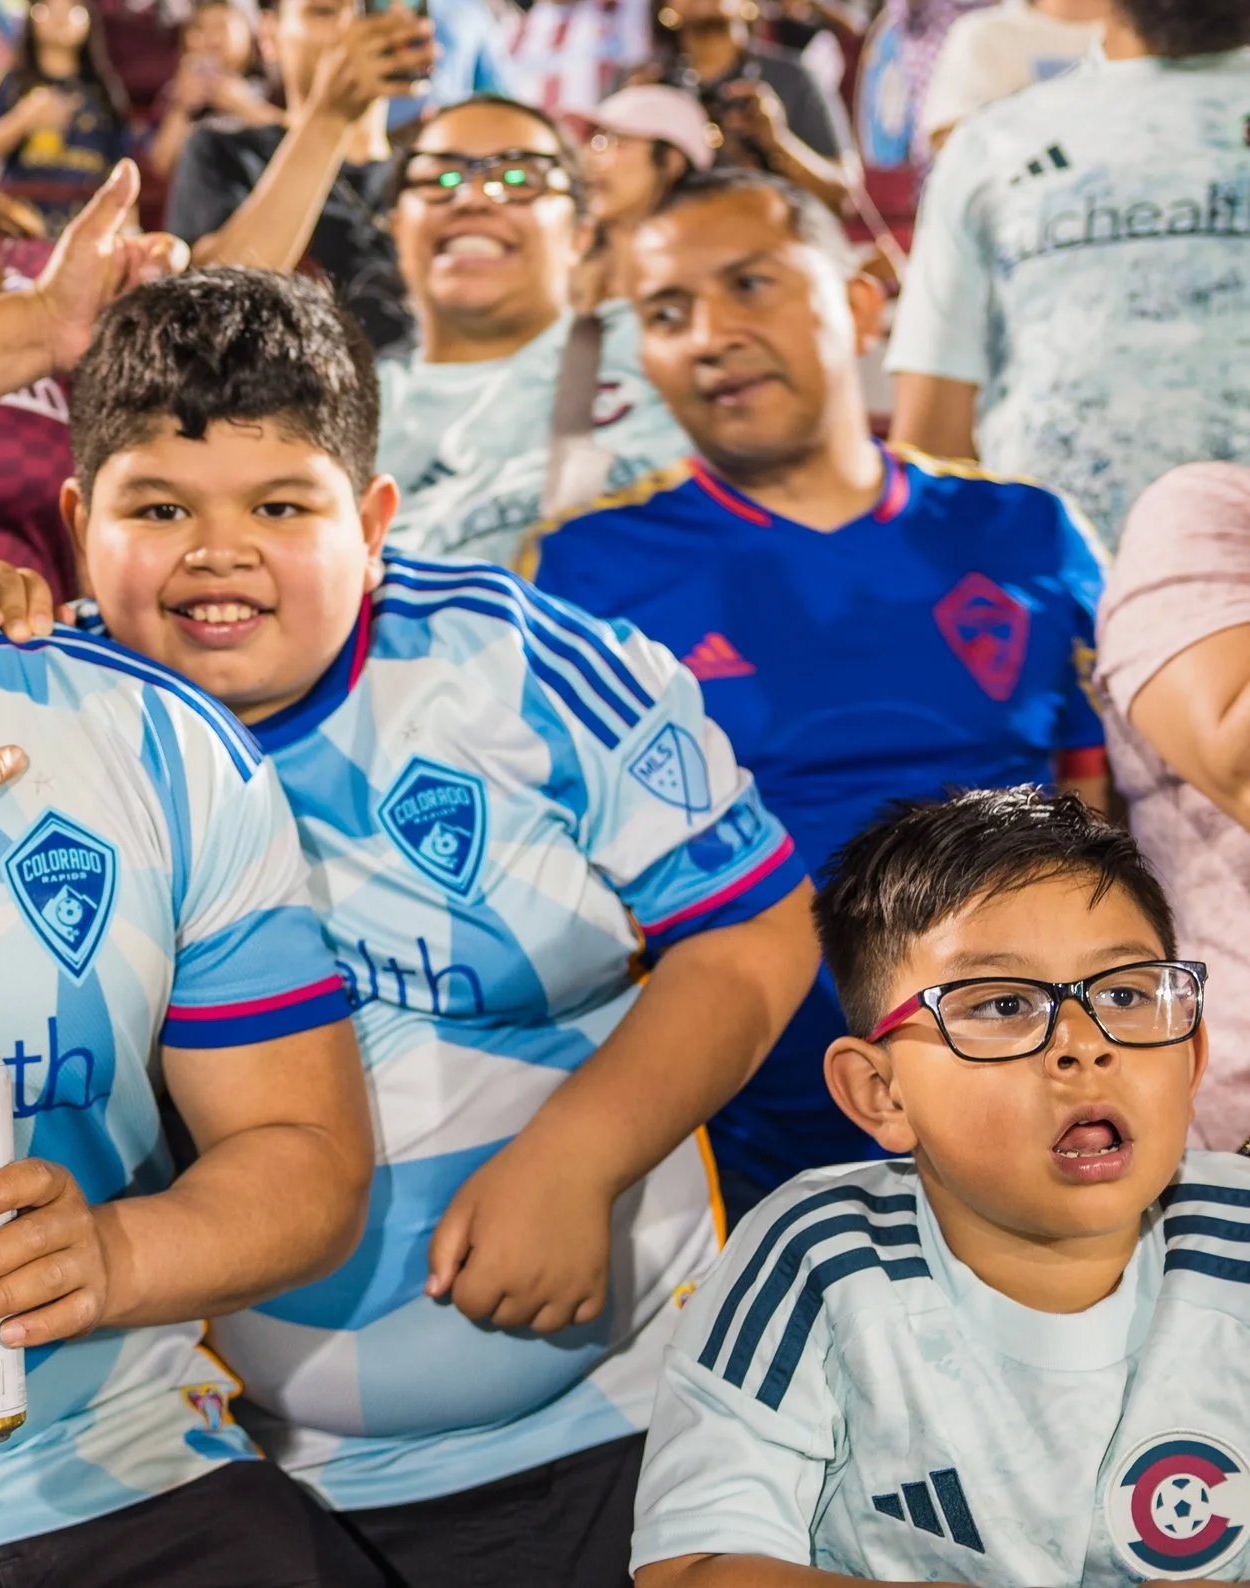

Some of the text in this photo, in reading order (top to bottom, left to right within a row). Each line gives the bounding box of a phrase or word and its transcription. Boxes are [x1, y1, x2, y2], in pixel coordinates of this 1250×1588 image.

[638, 742, 673, 778] MLS
[394, 786, 471, 826] COLORADO
[22, 848, 102, 882] COLORADO
[41, 871, 88, 884] RAPIDS
